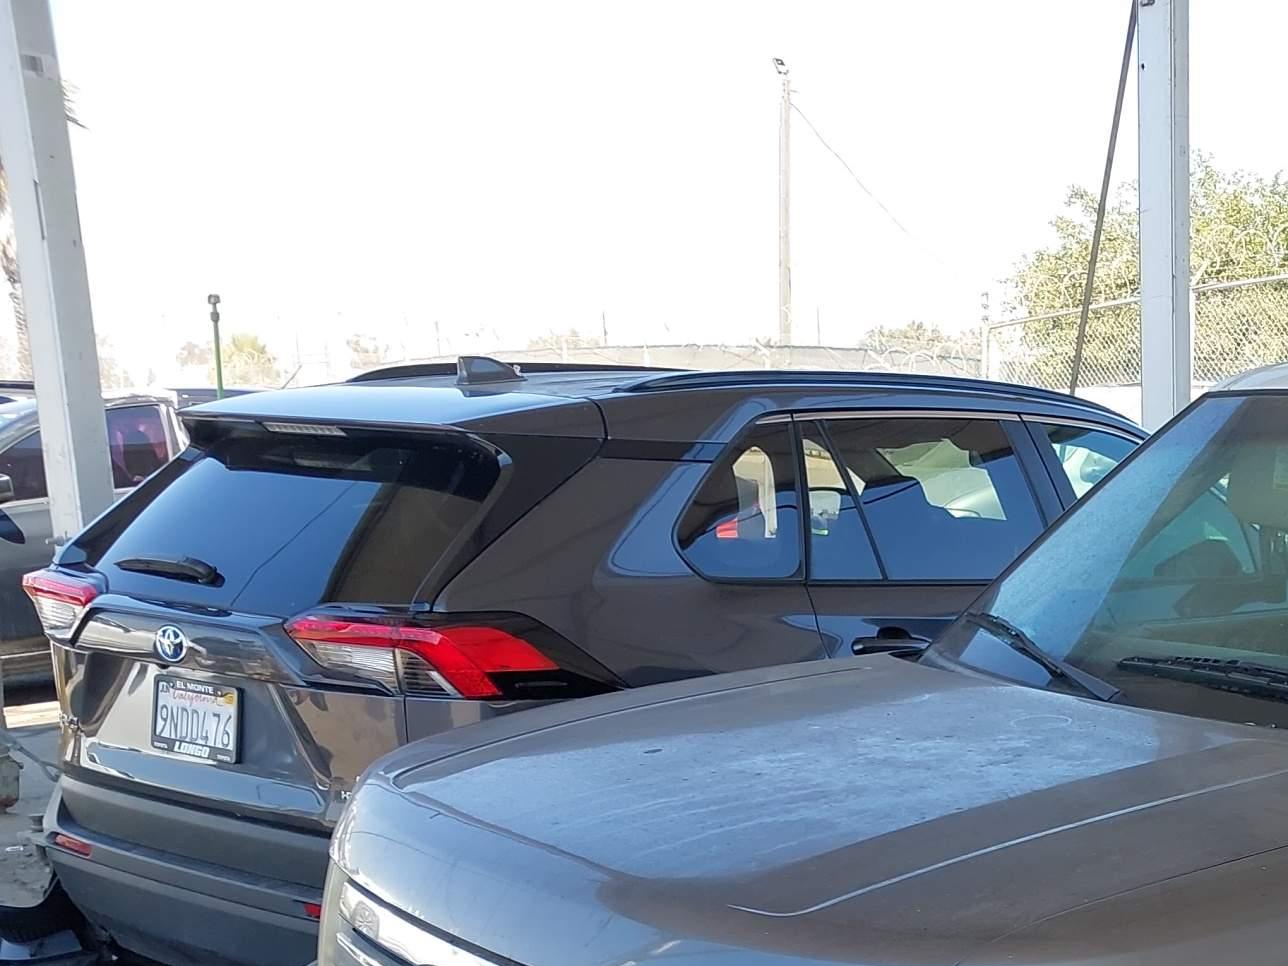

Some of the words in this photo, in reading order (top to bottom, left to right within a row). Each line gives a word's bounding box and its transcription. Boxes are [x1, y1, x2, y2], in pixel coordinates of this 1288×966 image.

[176, 681, 186, 689] EL
[187, 682, 214, 694] MONTE
[159, 704, 233, 748] 9NDD476
[174, 741, 210, 758] LONGO
